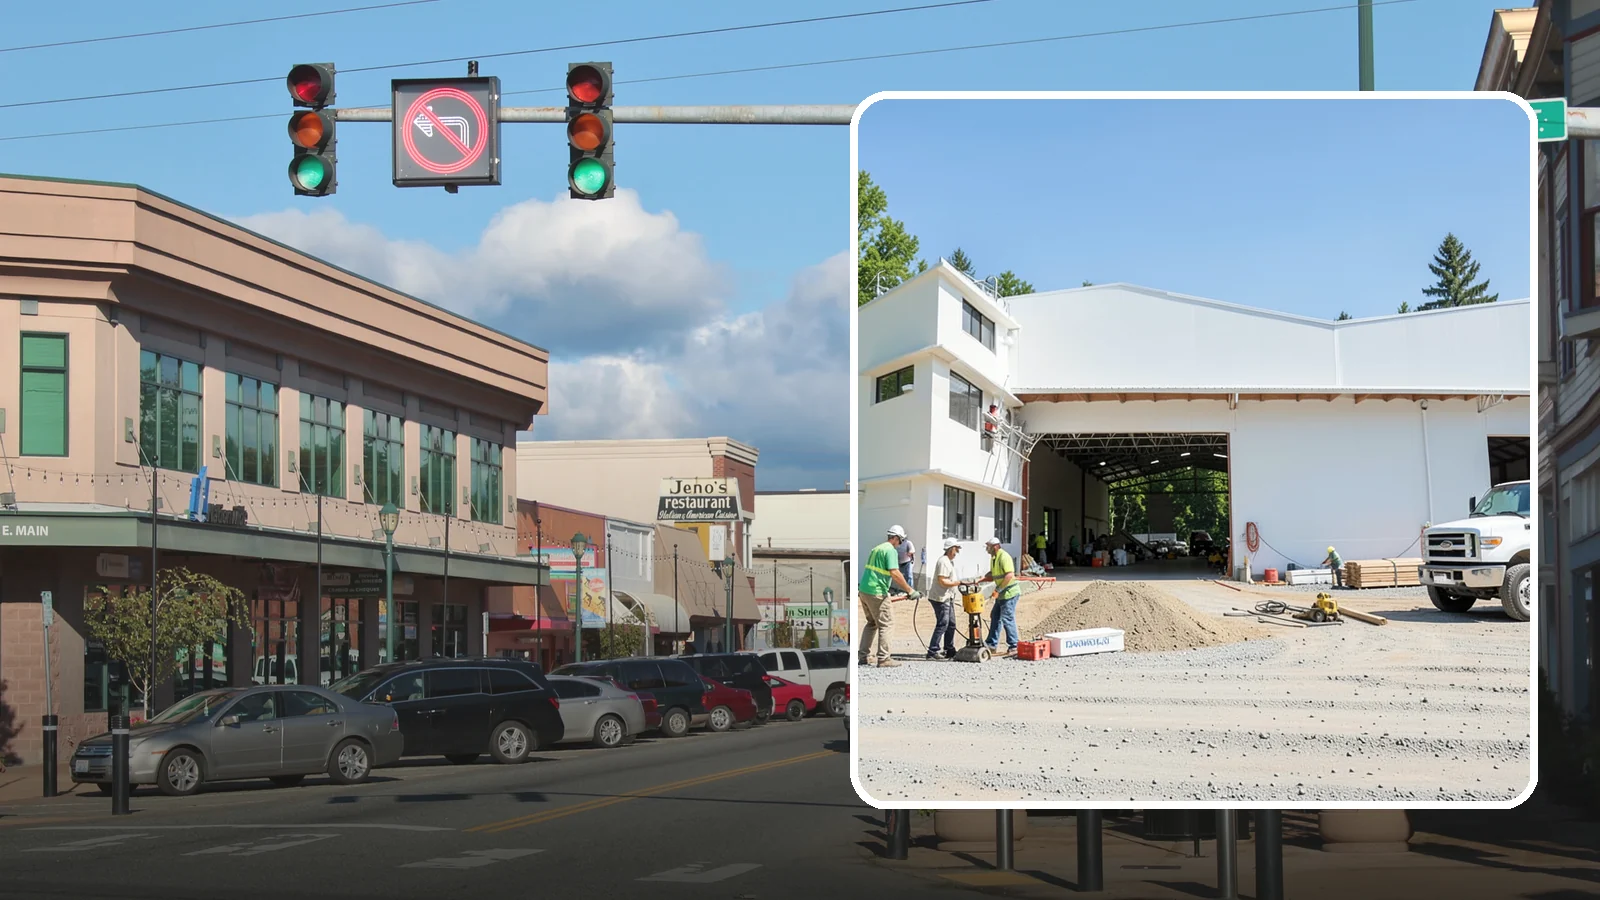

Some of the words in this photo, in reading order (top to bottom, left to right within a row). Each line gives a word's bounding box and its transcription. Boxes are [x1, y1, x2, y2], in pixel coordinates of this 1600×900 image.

[669, 480, 727, 495] Jeno's
[665, 496, 731, 509] restaurant
[658, 509, 682, 519] Italian
[686, 509, 714, 519] American
[715, 509, 738, 519] Cuisine
[2, 525, 13, 536] E.
[15, 525, 49, 536] MAIN
[786, 607, 795, 617] in
[797, 607, 829, 617] Street
[791, 619, 824, 627] lass
